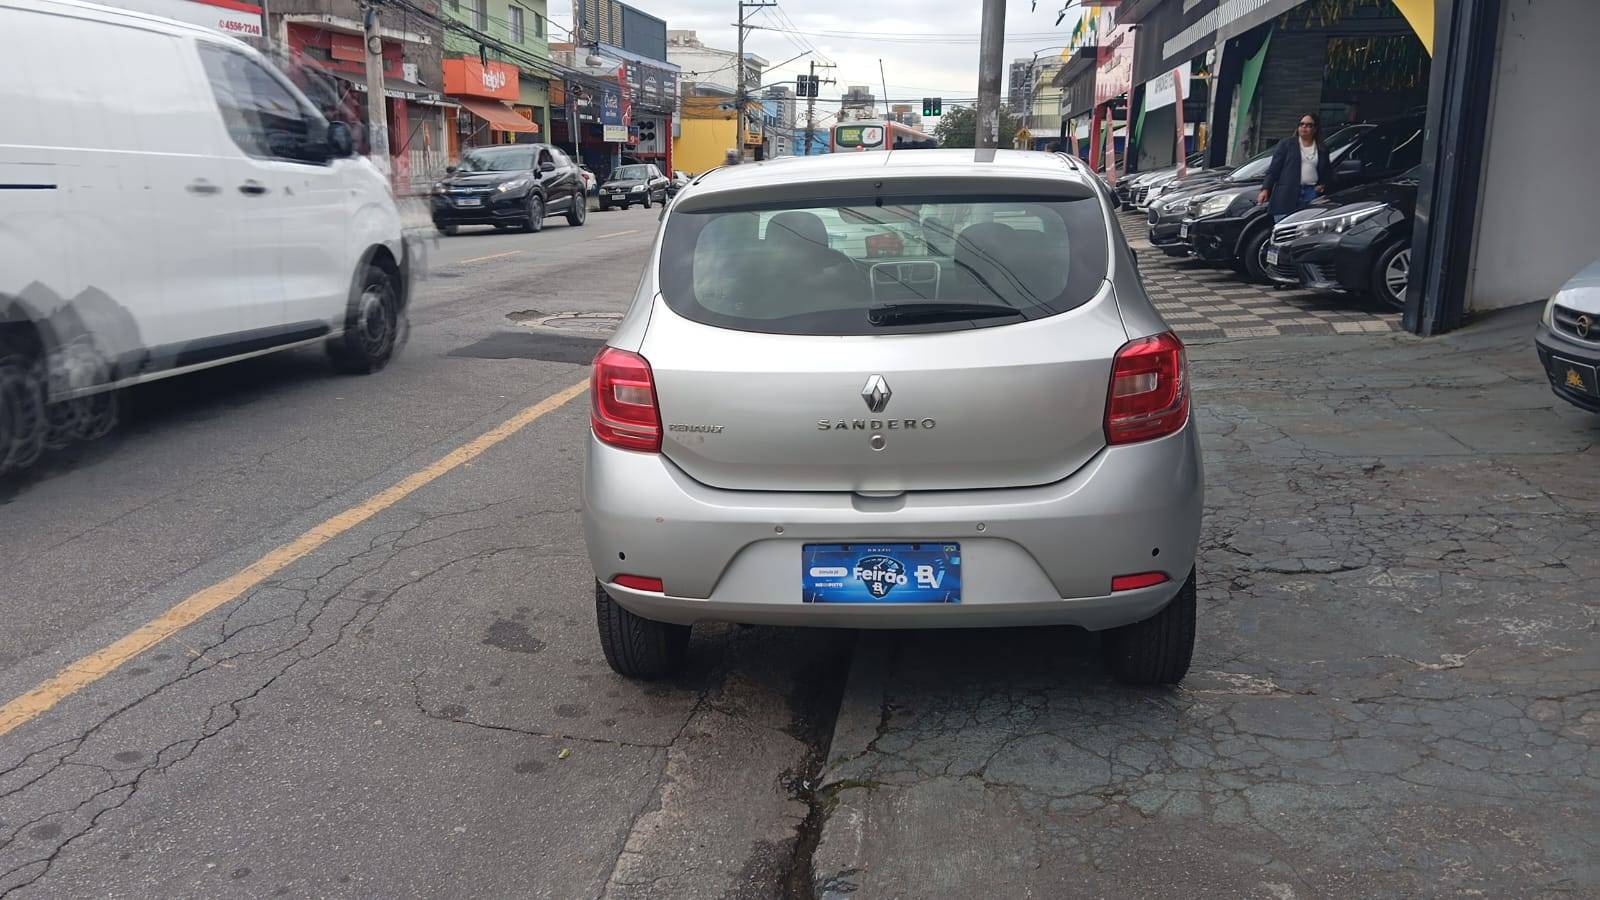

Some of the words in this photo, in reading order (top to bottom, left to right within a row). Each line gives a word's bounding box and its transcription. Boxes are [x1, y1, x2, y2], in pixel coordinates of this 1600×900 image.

[668, 423, 725, 434] RENAULT
[817, 416, 937, 431] SANDERO
[853, 566, 908, 586] Feirão
